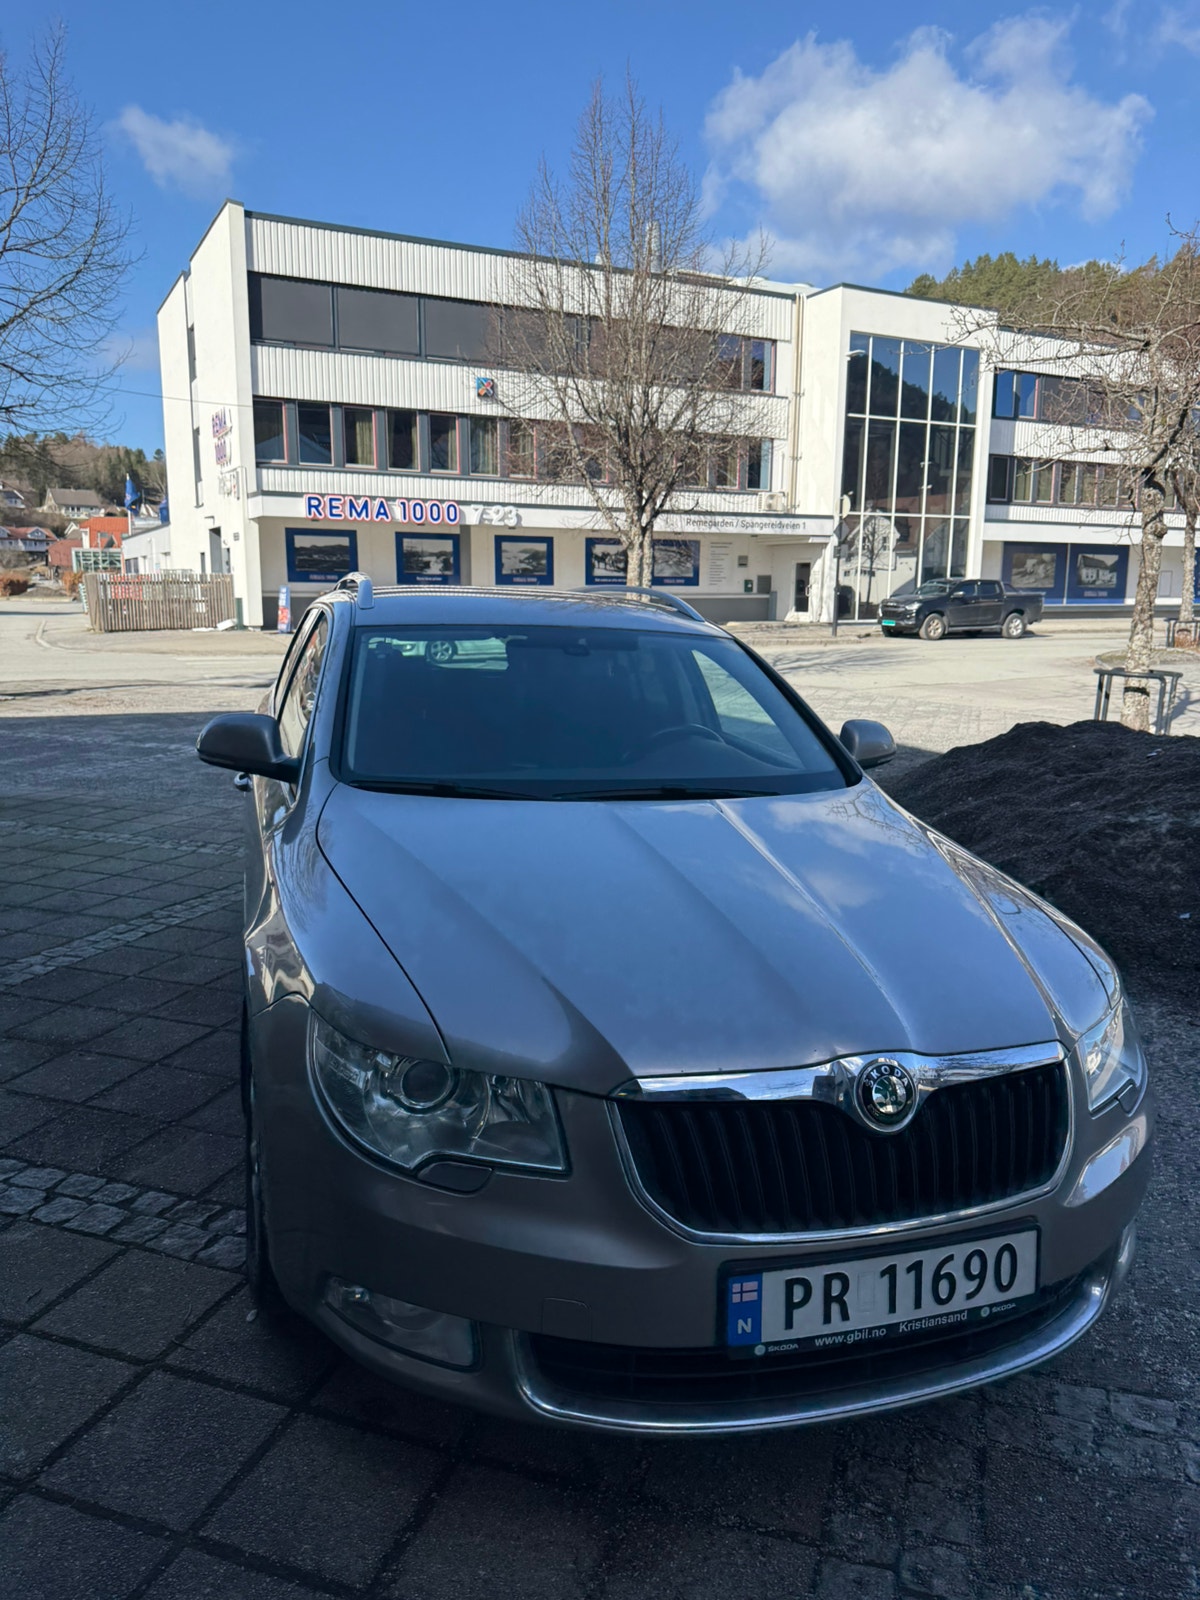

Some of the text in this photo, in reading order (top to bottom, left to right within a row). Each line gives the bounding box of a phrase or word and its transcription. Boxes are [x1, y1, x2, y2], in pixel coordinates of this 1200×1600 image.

[304, 495, 518, 526] REMA 1000 7-23
[802, 521, 806, 529] 1
[784, 1242, 1018, 1330] PR 11690
[737, 1318, 752, 1334] N
[814, 1310, 968, 1346] www.gbil.no Kristiansand
